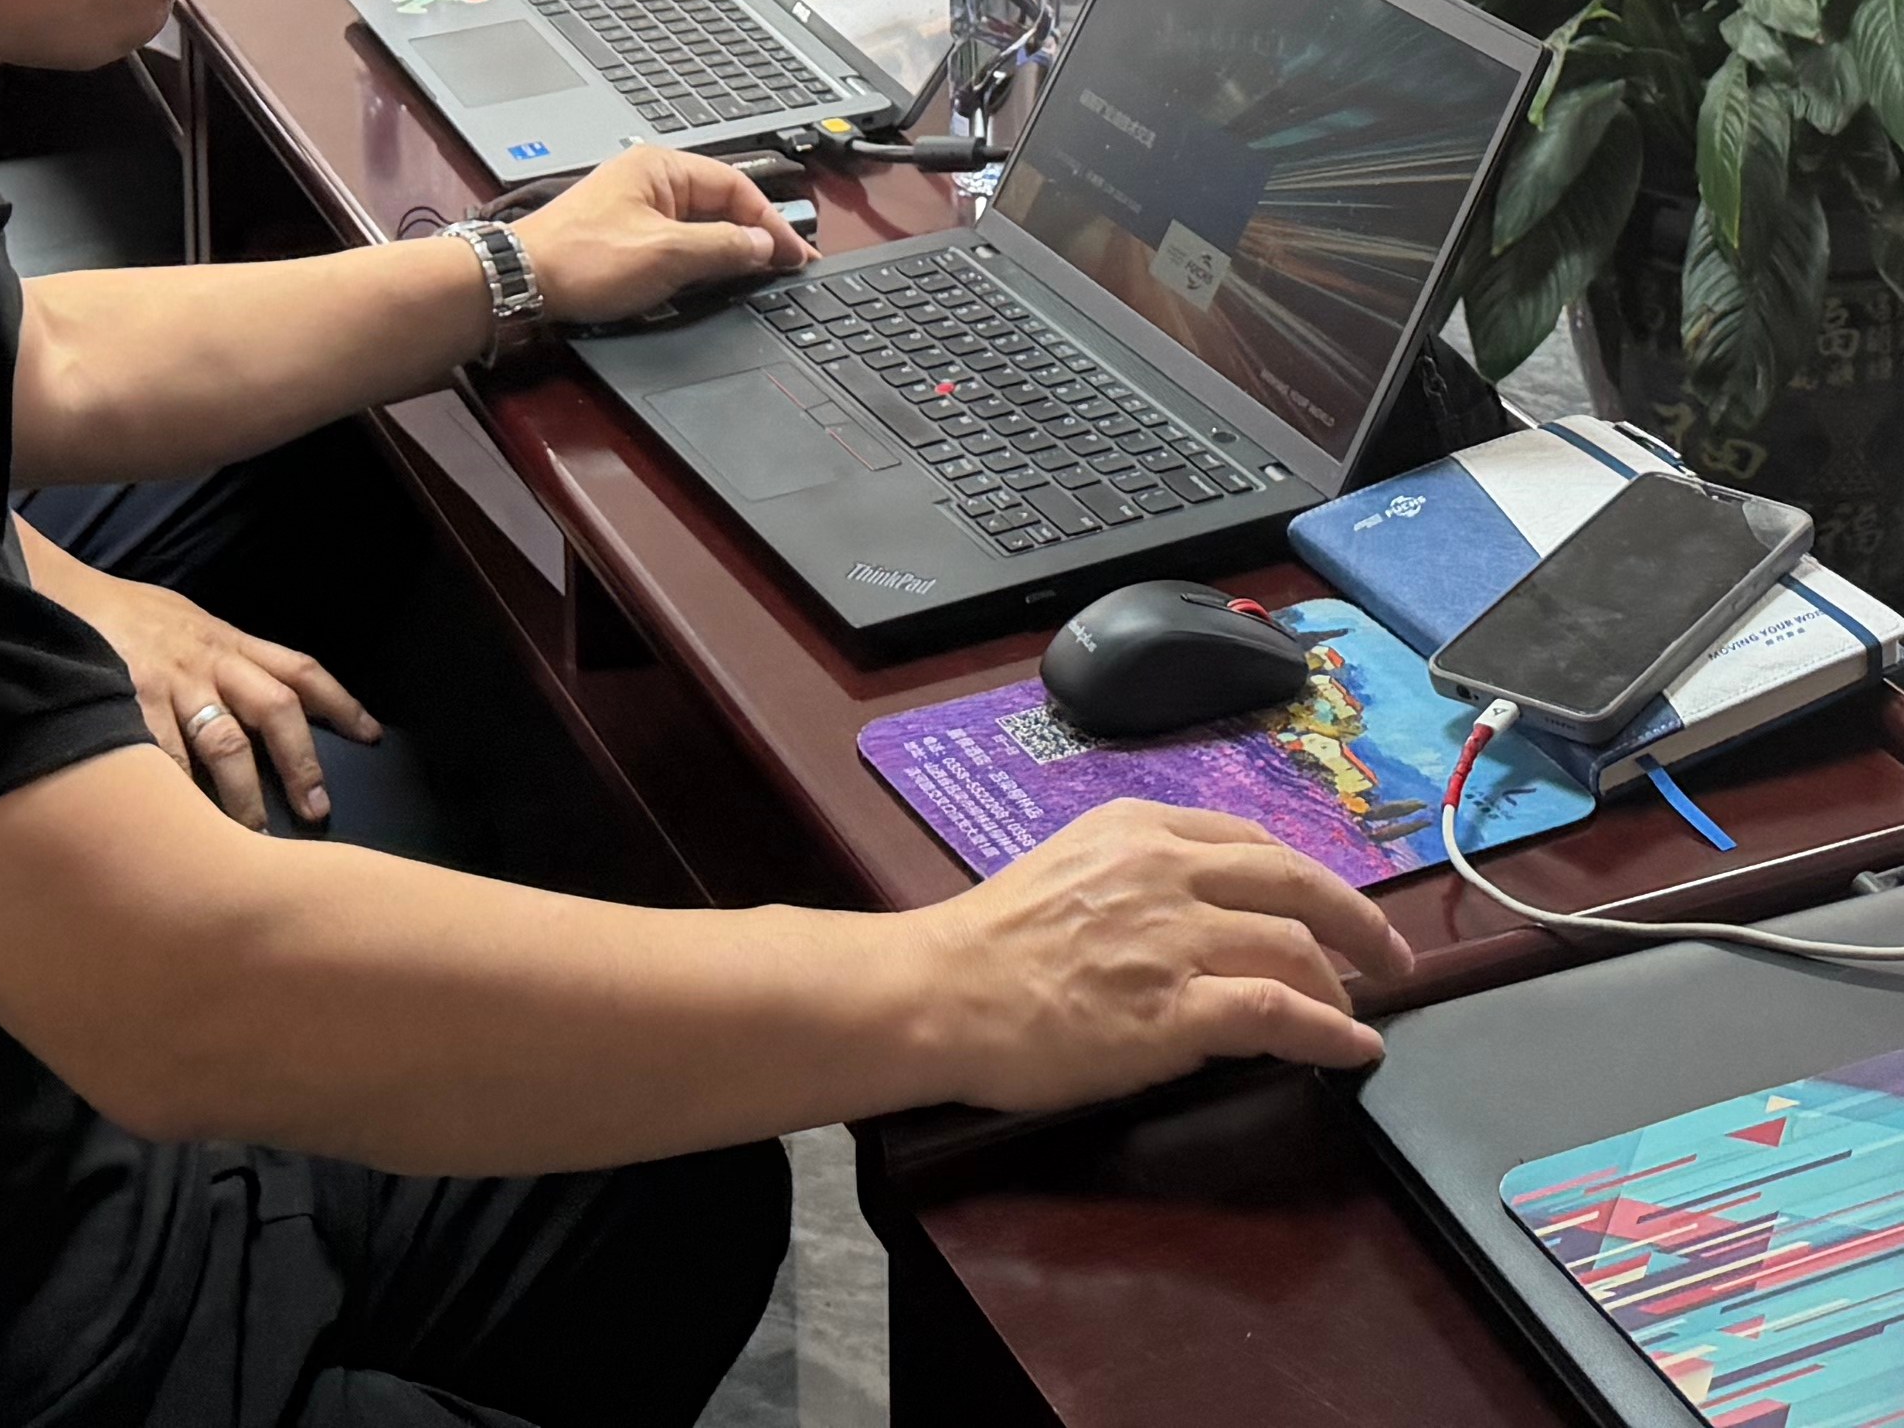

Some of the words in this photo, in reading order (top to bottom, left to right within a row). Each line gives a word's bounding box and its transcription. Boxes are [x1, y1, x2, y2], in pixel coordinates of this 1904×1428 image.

[846, 562, 936, 596] ThinkPad
[1708, 633, 1760, 661] MOVING
[1759, 619, 1794, 637] YOUR
